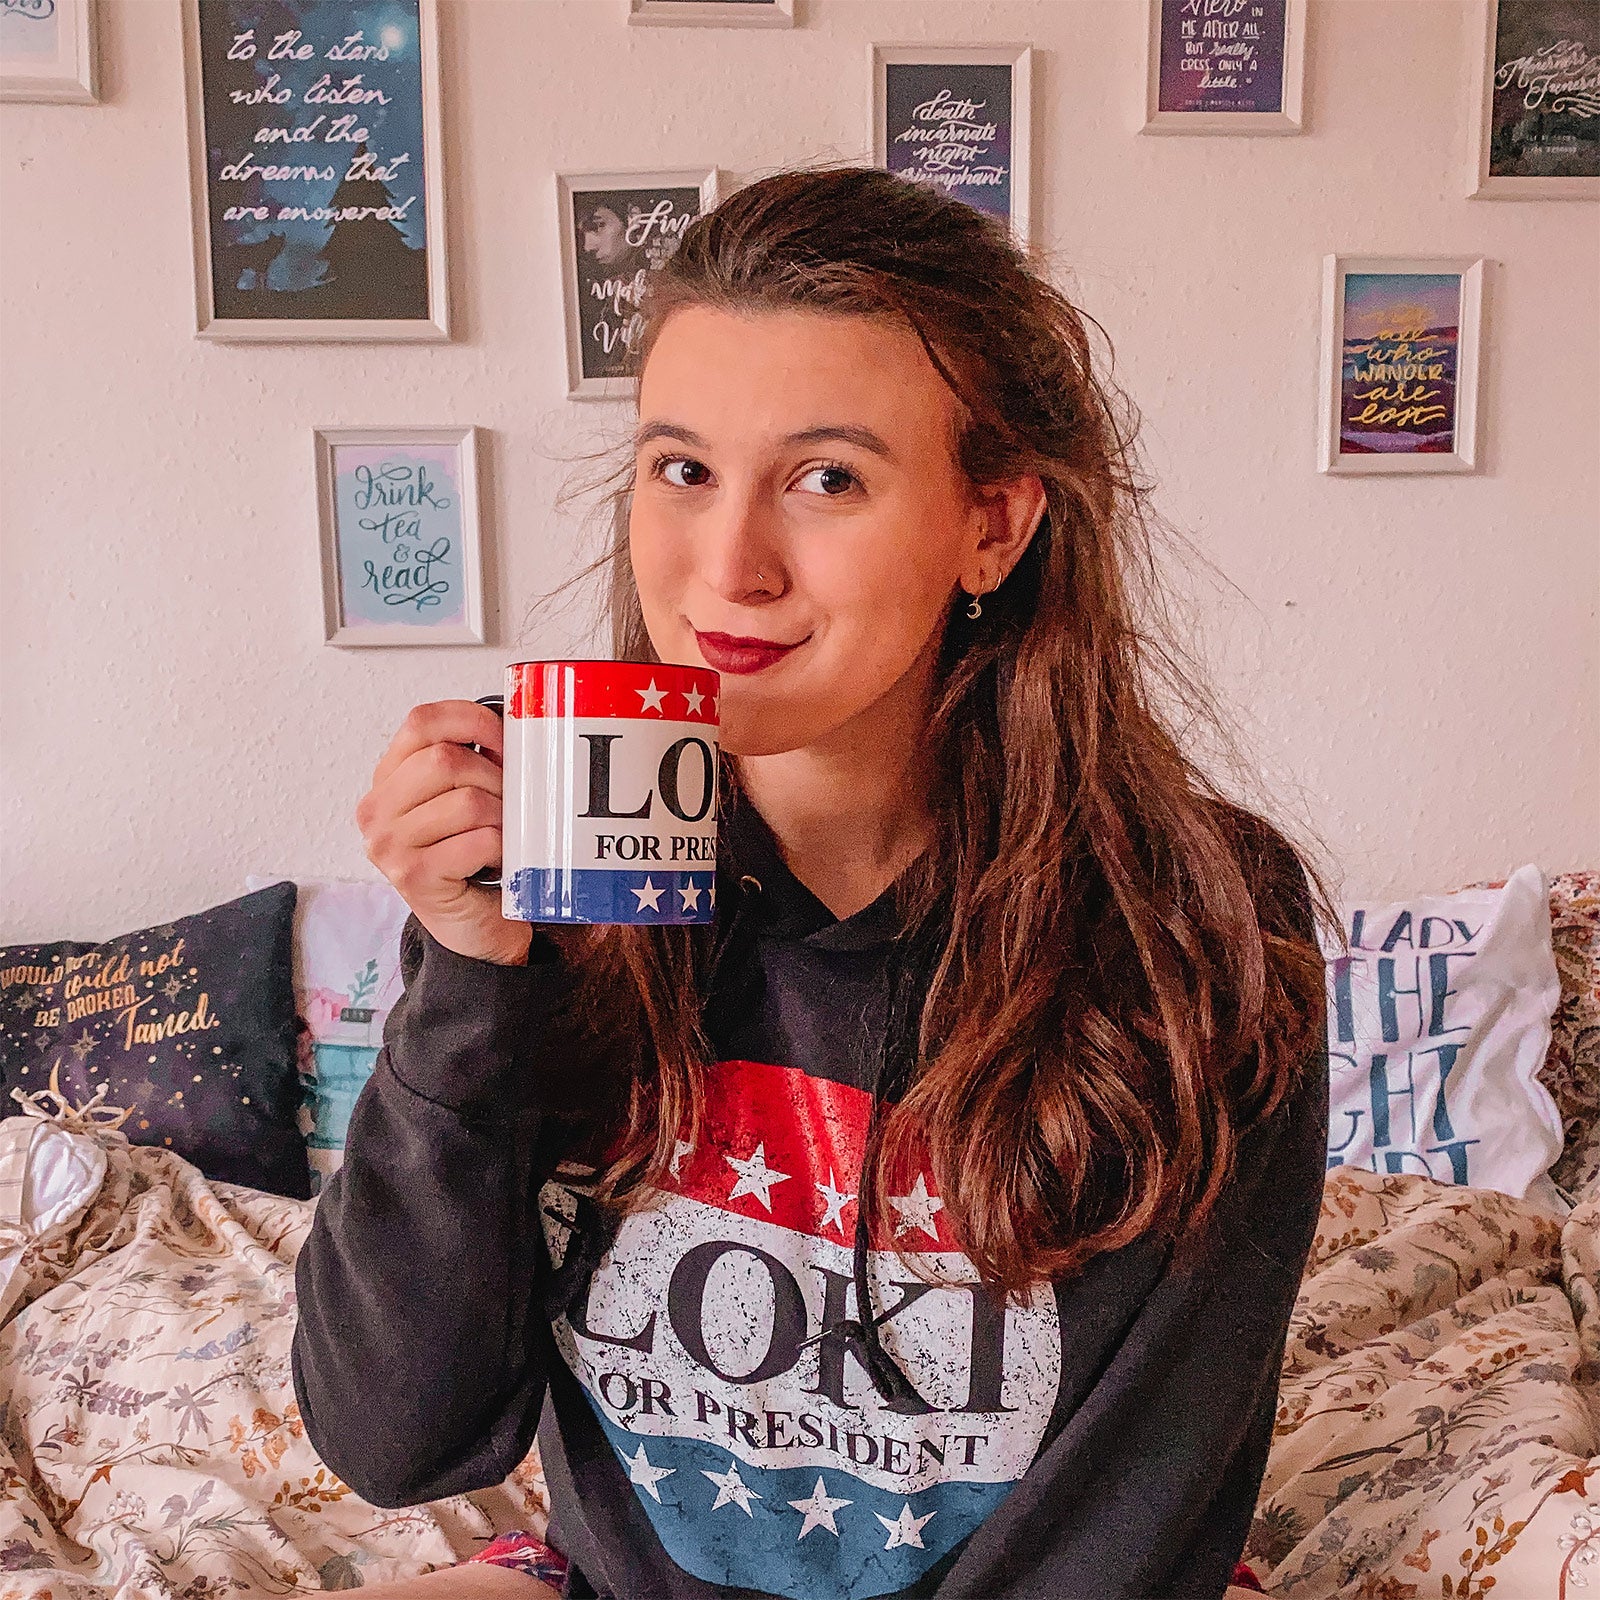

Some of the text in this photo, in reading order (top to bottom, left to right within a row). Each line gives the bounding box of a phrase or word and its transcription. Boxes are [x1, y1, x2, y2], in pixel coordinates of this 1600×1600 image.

[1251, 6, 1264, 17] IN
[1181, 20, 1197, 39] ME
[1202, 20, 1239, 39] AFTER
[226, 29, 391, 61] to the stars
[1185, 41, 1204, 55] BUT
[1218, 59, 1243, 72] ONLY
[1249, 59, 1258, 72] A
[229, 73, 393, 107] who listen
[912, 89, 987, 121] death
[254, 114, 371, 145] and the
[895, 120, 998, 143] incarnate
[219, 152, 411, 182] dreams that
[913, 142, 989, 171] night
[222, 196, 418, 223] are answered
[625, 200, 691, 248] Fin
[591, 269, 648, 316] Mak
[1364, 342, 1449, 362] who
[1354, 364, 1445, 382] WANDER
[1353, 383, 1441, 402] are
[1349, 403, 1446, 427] lost
[354, 463, 450, 510] Drink
[358, 510, 422, 544] tea
[393, 543, 411, 563] &
[361, 537, 450, 606] read
[577, 734, 719, 823] LO
[594, 834, 663, 861] FOR
[1350, 909, 1485, 953] LADY
[0, 964, 65, 990] WOULD
[64, 937, 186, 1000] could not
[1333, 951, 1479, 1044] THE
[33, 1008, 61, 1028] BE
[692, 1388, 990, 1476] PRESIDENT
